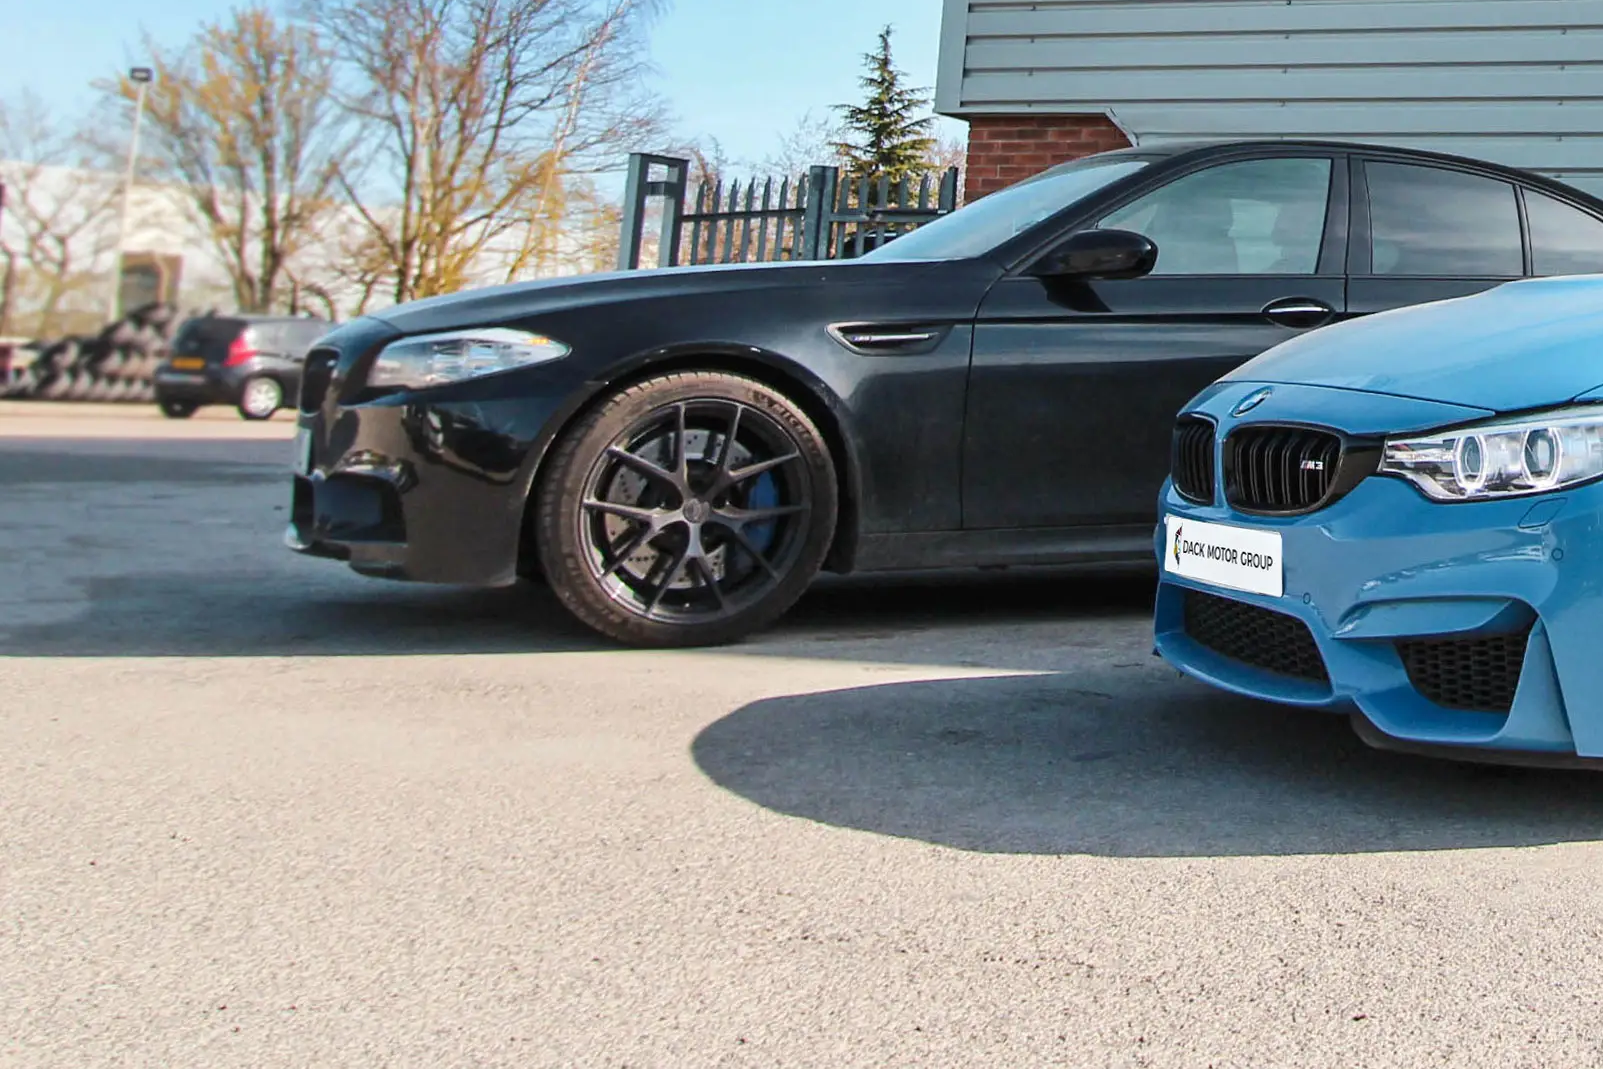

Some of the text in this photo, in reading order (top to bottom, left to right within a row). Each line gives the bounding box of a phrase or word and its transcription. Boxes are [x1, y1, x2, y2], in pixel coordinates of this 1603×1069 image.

[1183, 540, 1274, 571] DACK MOTOR GROUP
